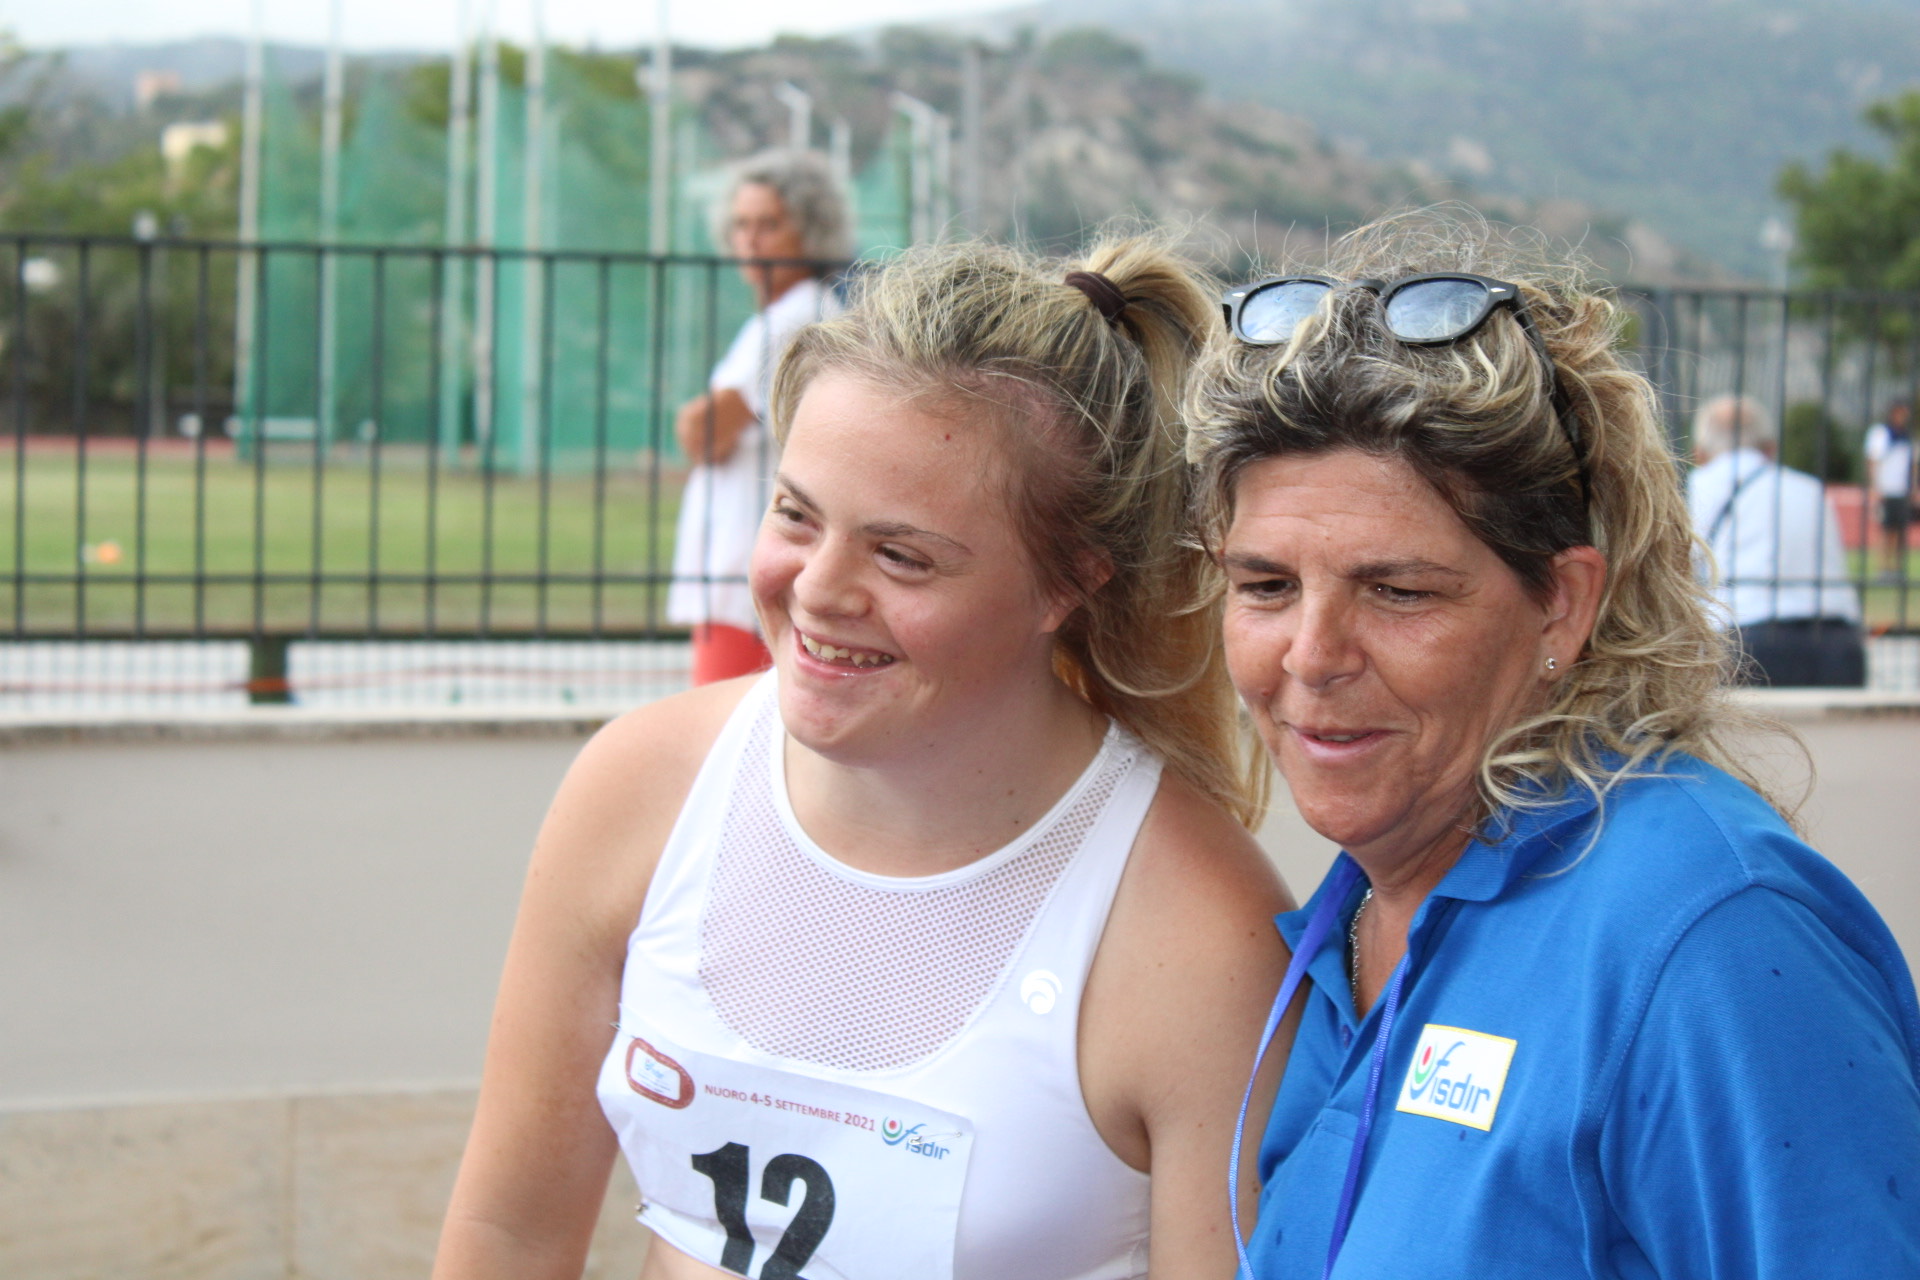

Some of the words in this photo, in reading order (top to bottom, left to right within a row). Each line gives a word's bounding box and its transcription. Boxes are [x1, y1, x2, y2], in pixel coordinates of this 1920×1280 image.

[704, 1084, 748, 1102] NUORO
[750, 1093, 773, 1107] 4-5
[775, 1098, 841, 1122] SETTEMBRE
[844, 1112, 876, 1132] 2021
[691, 1141, 836, 1280] 12
